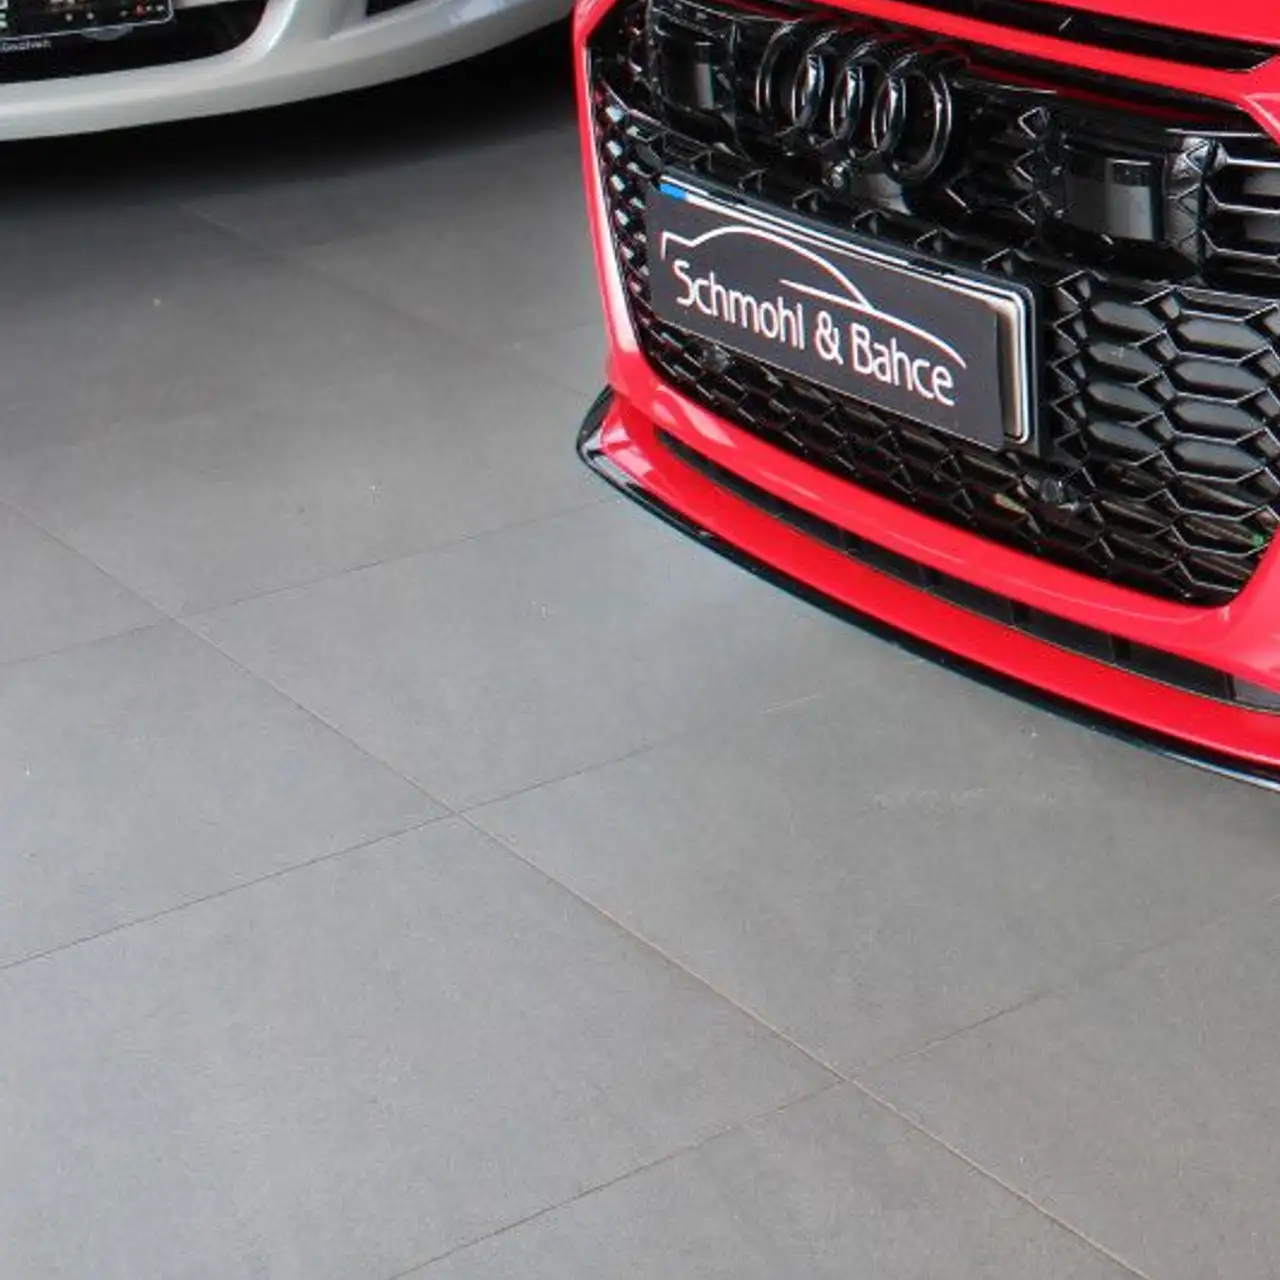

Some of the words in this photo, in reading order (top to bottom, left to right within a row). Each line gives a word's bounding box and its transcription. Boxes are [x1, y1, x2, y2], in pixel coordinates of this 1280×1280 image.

[672, 258, 806, 351] Schmohl
[813, 310, 844, 366] &
[849, 322, 956, 408] Bahce
